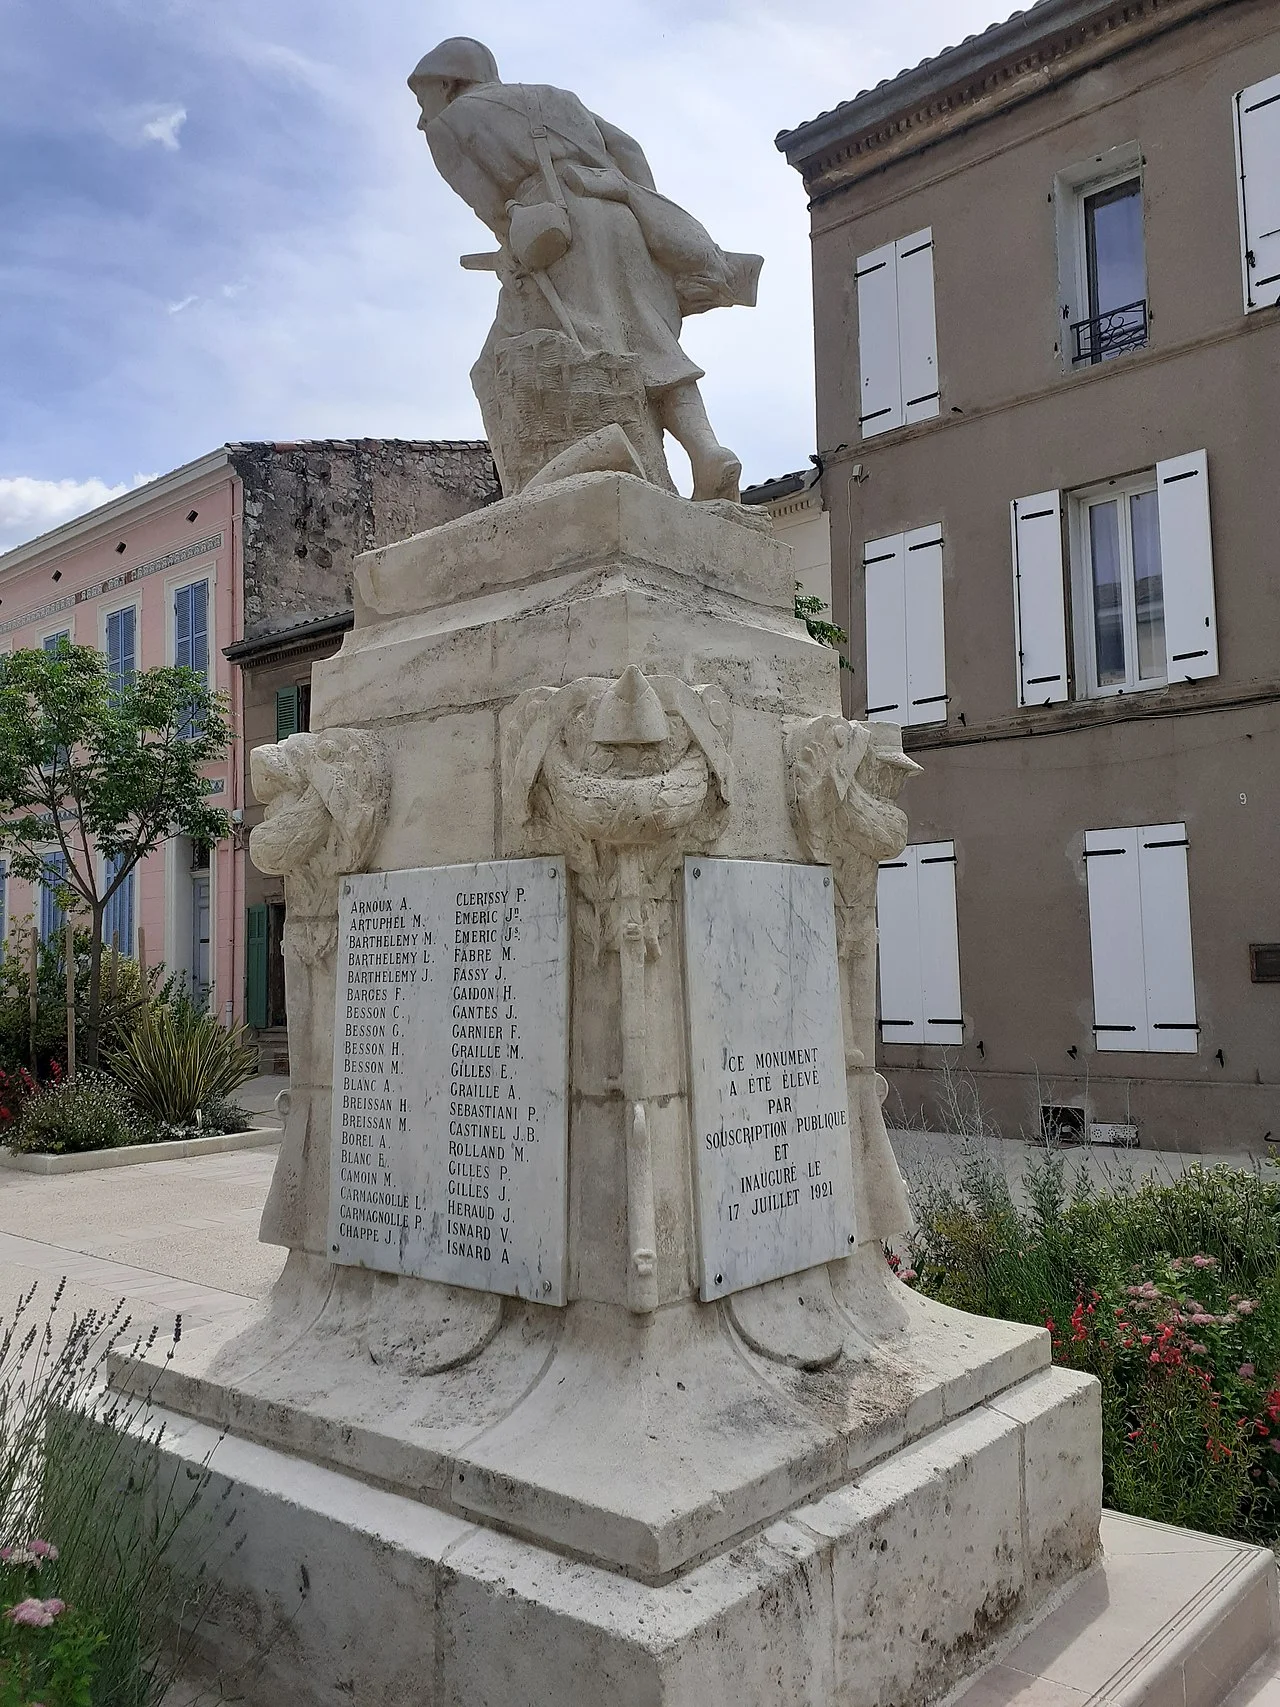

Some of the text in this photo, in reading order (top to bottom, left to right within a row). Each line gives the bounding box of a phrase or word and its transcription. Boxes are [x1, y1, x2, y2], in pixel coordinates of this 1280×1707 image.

[1239, 792, 1247, 805] 9
[456, 888, 526, 906] CLERISSY P.
[351, 898, 412, 914] ARNOUX A.
[350, 914, 425, 932] ARTUPHEL M.
[455, 910, 498, 925] EMERIC
[349, 932, 436, 949] BARTHELEMY M.
[455, 929, 497, 944] EMERIC
[348, 952, 417, 967] BARTHELEMY
[454, 947, 516, 963] FABRE M.
[348, 969, 433, 984] BARTHELEMY J.
[453, 966, 507, 982] FASSY J.
[347, 988, 405, 1002] BARGES F.
[453, 986, 516, 1001] GAIDON H.
[347, 1006, 404, 1019] BESSON C.
[453, 1005, 517, 1020] GANTES J.
[346, 1023, 404, 1038] BESSON G.
[452, 1024, 521, 1040] GARNIER F.
[345, 1041, 404, 1056] BESSON H.
[452, 1043, 524, 1059] GRAILLE M.
[344, 1059, 403, 1074] BESSON M.
[728, 1048, 818, 1072] CE MONUMENT
[451, 1063, 513, 1079] GILLES E.
[343, 1077, 395, 1092] BLANC A.
[451, 1082, 521, 1100] GRAILLE A.
[729, 1081, 737, 1096] A
[343, 1095, 412, 1112] BREISSAN H.
[450, 1102, 539, 1122] SEBASTIANI P.
[768, 1097, 792, 1115] PAR
[342, 1113, 411, 1131] BREISSAN M.
[450, 1121, 506, 1140] CASTINEL
[706, 1110, 847, 1150] SOUSCRIPTION PUBLIQUE
[342, 1131, 390, 1148] BOREL A.
[342, 1150, 371, 1166] BLANC
[449, 1141, 529, 1162] ROLLAND M.
[774, 1144, 789, 1161] ET
[341, 1168, 396, 1187] CAMOIN M.
[449, 1160, 510, 1181] GILLES P.
[808, 1161, 821, 1177] LE
[341, 1186, 426, 1210] CARMAGNOLLE L.
[448, 1180, 510, 1201] GILLES J.
[728, 1181, 833, 1221] 17 JUILLET 1921
[340, 1204, 425, 1230] CARMAGNOLLE P.
[448, 1200, 514, 1223] HERAUD J.
[340, 1223, 396, 1245] CHAPPE J.
[447, 1220, 512, 1243] ISNARD V.
[447, 1239, 491, 1261] ISNARD
